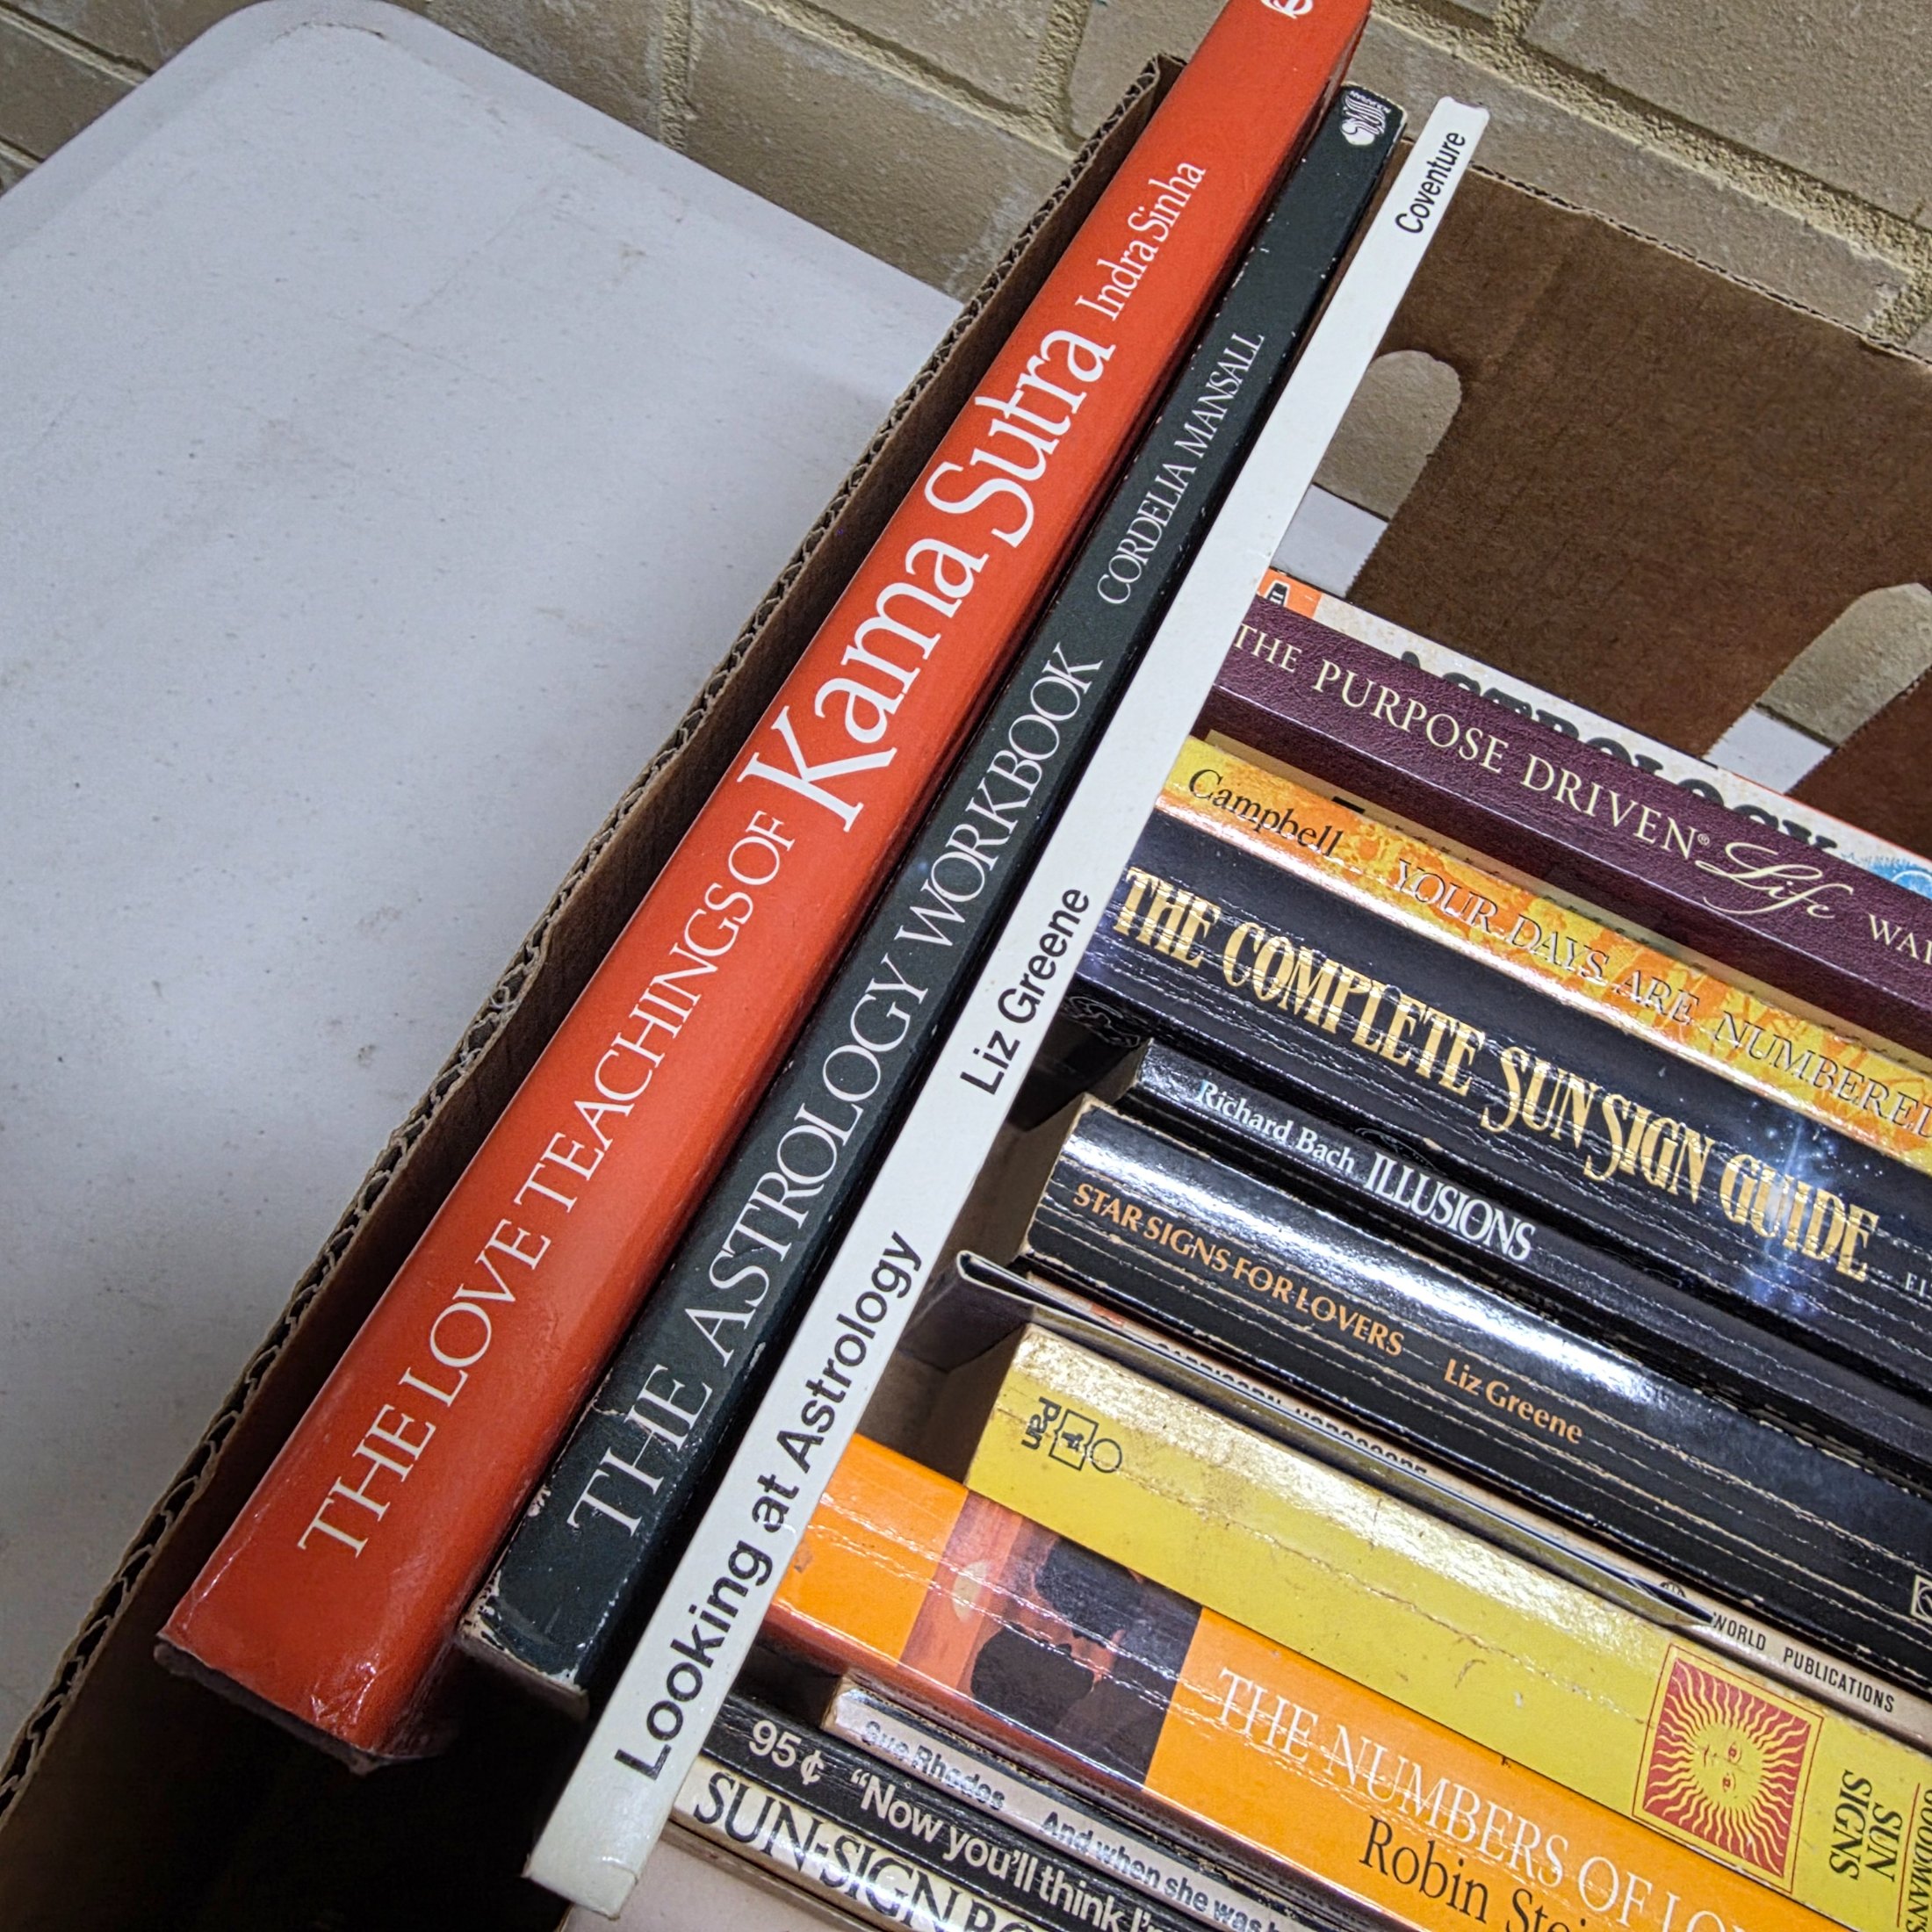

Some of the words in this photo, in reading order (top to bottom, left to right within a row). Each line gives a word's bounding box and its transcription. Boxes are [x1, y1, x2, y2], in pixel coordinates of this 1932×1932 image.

[1076, 240, 1158, 321] Indra
[1128, 162, 1206, 242] Sinha
[1395, 132, 1466, 234] Coventure
[924, 329, 1116, 548] Sutra
[1096, 463, 1196, 605] CORDELIA
[1174, 333, 1265, 459] MANSALL
[737, 538, 989, 832] Kama
[728, 811, 796, 885] OF
[1188, 768, 1343, 857] Campbell
[1233, 623, 1302, 673] THE
[1312, 659, 1510, 775] PURPOSE
[1695, 841, 1853, 919] Life
[960, 1029, 1020, 1095] Liz
[998, 889, 1089, 1023] Greene
[1389, 858, 1501, 934] YOUR
[1505, 914, 1610, 984] DAYS
[1614, 970, 1699, 1026] ARE
[514, 882, 753, 1213] TEACHINGS
[566, 1364, 712, 1537] THE
[685, 953, 928, 1366] ASTROLOGY
[894, 642, 1103, 947] WORKBOOK
[1114, 866, 1222, 968] THE
[1222, 921, 1486, 1097] COMPLETE
[1481, 1047, 1604, 1149] SUN
[1583, 1093, 1715, 1204] SIGN
[1719, 1153, 1879, 1282] GUIDE
[1195, 1079, 1294, 1143] Richard
[1295, 1126, 1357, 1176] Bach
[1073, 1183, 1142, 1233] STAR
[1143, 1215, 1230, 1274] SIGNS
[1232, 1256, 1294, 1304] FOR
[1295, 1287, 1404, 1358] LOVERS
[1362, 1151, 1537, 1263] ILLUSIONS
[399, 1219, 551, 1407] LOVE
[1444, 1359, 1483, 1395] Liz
[1485, 1381, 1582, 1445] Greene
[298, 1404, 436, 1558] THE
[616, 1540, 774, 1781] Looking
[752, 1474, 800, 1533] at
[776, 1231, 922, 1473] Astrology
[748, 1719, 825, 1784] 95¢
[1783, 1647, 1895, 1713] PUBLICATIONS
[861, 1721, 910, 1762] Sue
[912, 1745, 1006, 1810] Rhodes
[1216, 1667, 1318, 1764] THE
[1323, 1724, 1568, 1888] NUMBERS
[1578, 1856, 1653, 1928] OF
[1829, 1769, 1872, 1881] SIGNS
[1864, 1802, 1903, 1882] SUN
[1039, 1812, 1099, 1852] And
[1097, 1845, 1162, 1889] when
[1164, 1877, 1208, 1913] she
[1041, 1857, 1126, 1932] think
[1359, 1815, 1489, 1924] Robin
